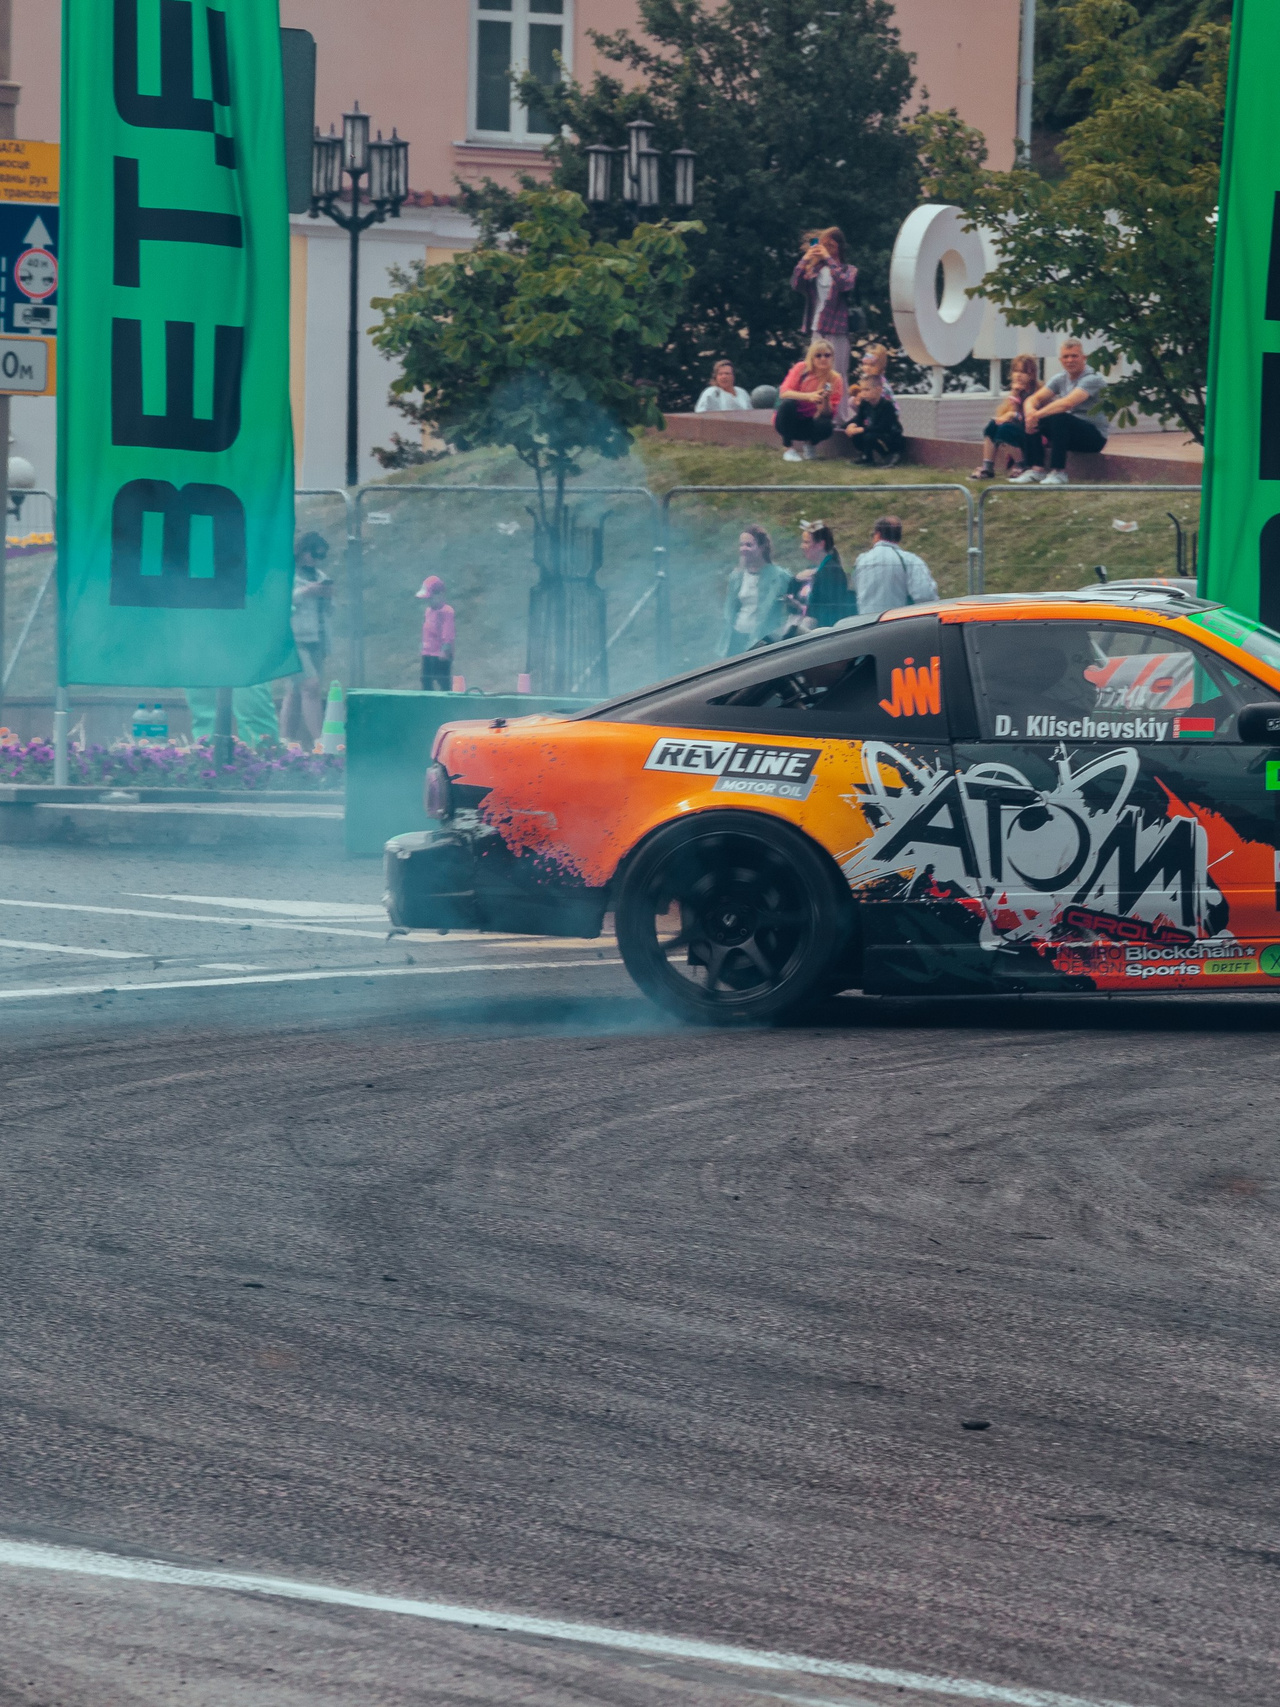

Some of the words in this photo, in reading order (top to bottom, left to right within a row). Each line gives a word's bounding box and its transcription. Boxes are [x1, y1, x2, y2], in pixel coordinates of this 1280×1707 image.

[995, 715, 1018, 736] D.
[1027, 716, 1169, 741] Klischevskiy
[721, 780, 776, 793] MOTOR
[778, 783, 803, 797] OIL
[1125, 943, 1243, 961] Blockchain
[1125, 961, 1201, 979] Sports
[1211, 962, 1251, 973] DRIFT
